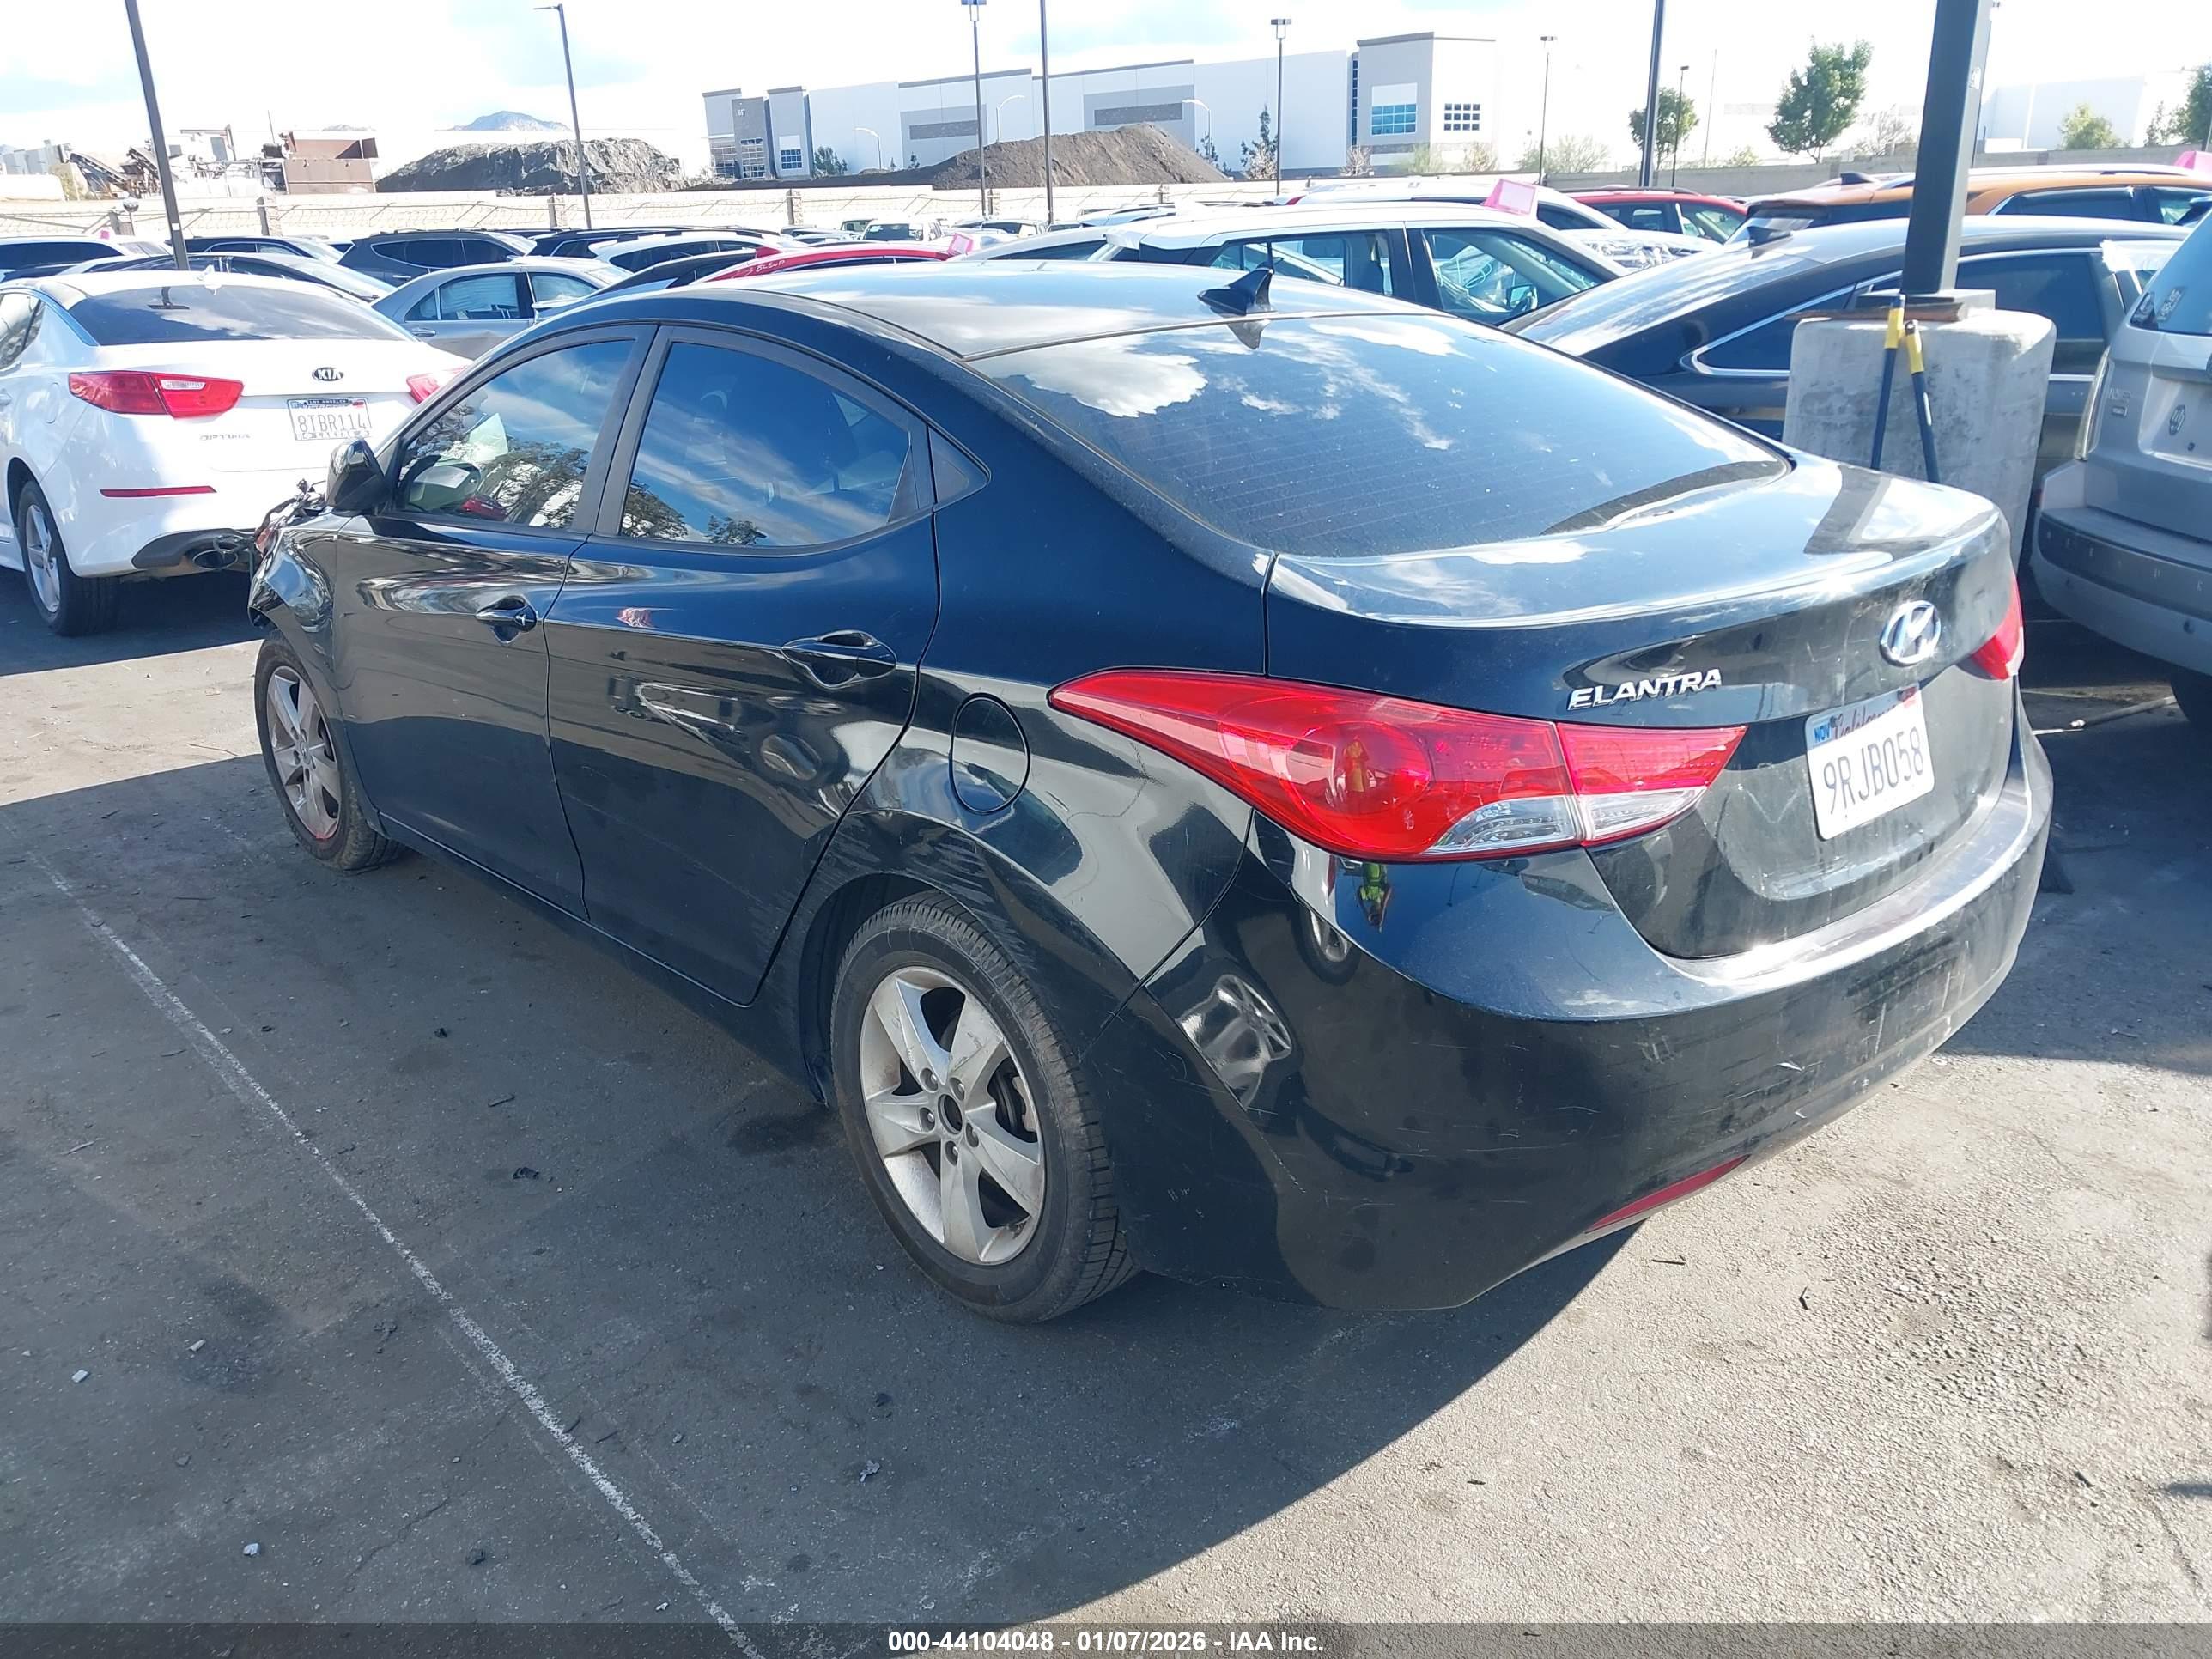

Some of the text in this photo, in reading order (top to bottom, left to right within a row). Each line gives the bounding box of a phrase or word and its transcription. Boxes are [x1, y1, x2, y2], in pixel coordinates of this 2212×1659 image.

[317, 368, 343, 380] KIA
[297, 413, 367, 433] 8TBR114
[1567, 668, 1723, 711] ELANTRA
[1814, 722, 1831, 744] NOV
[1823, 726, 1924, 815] 9RJB058
